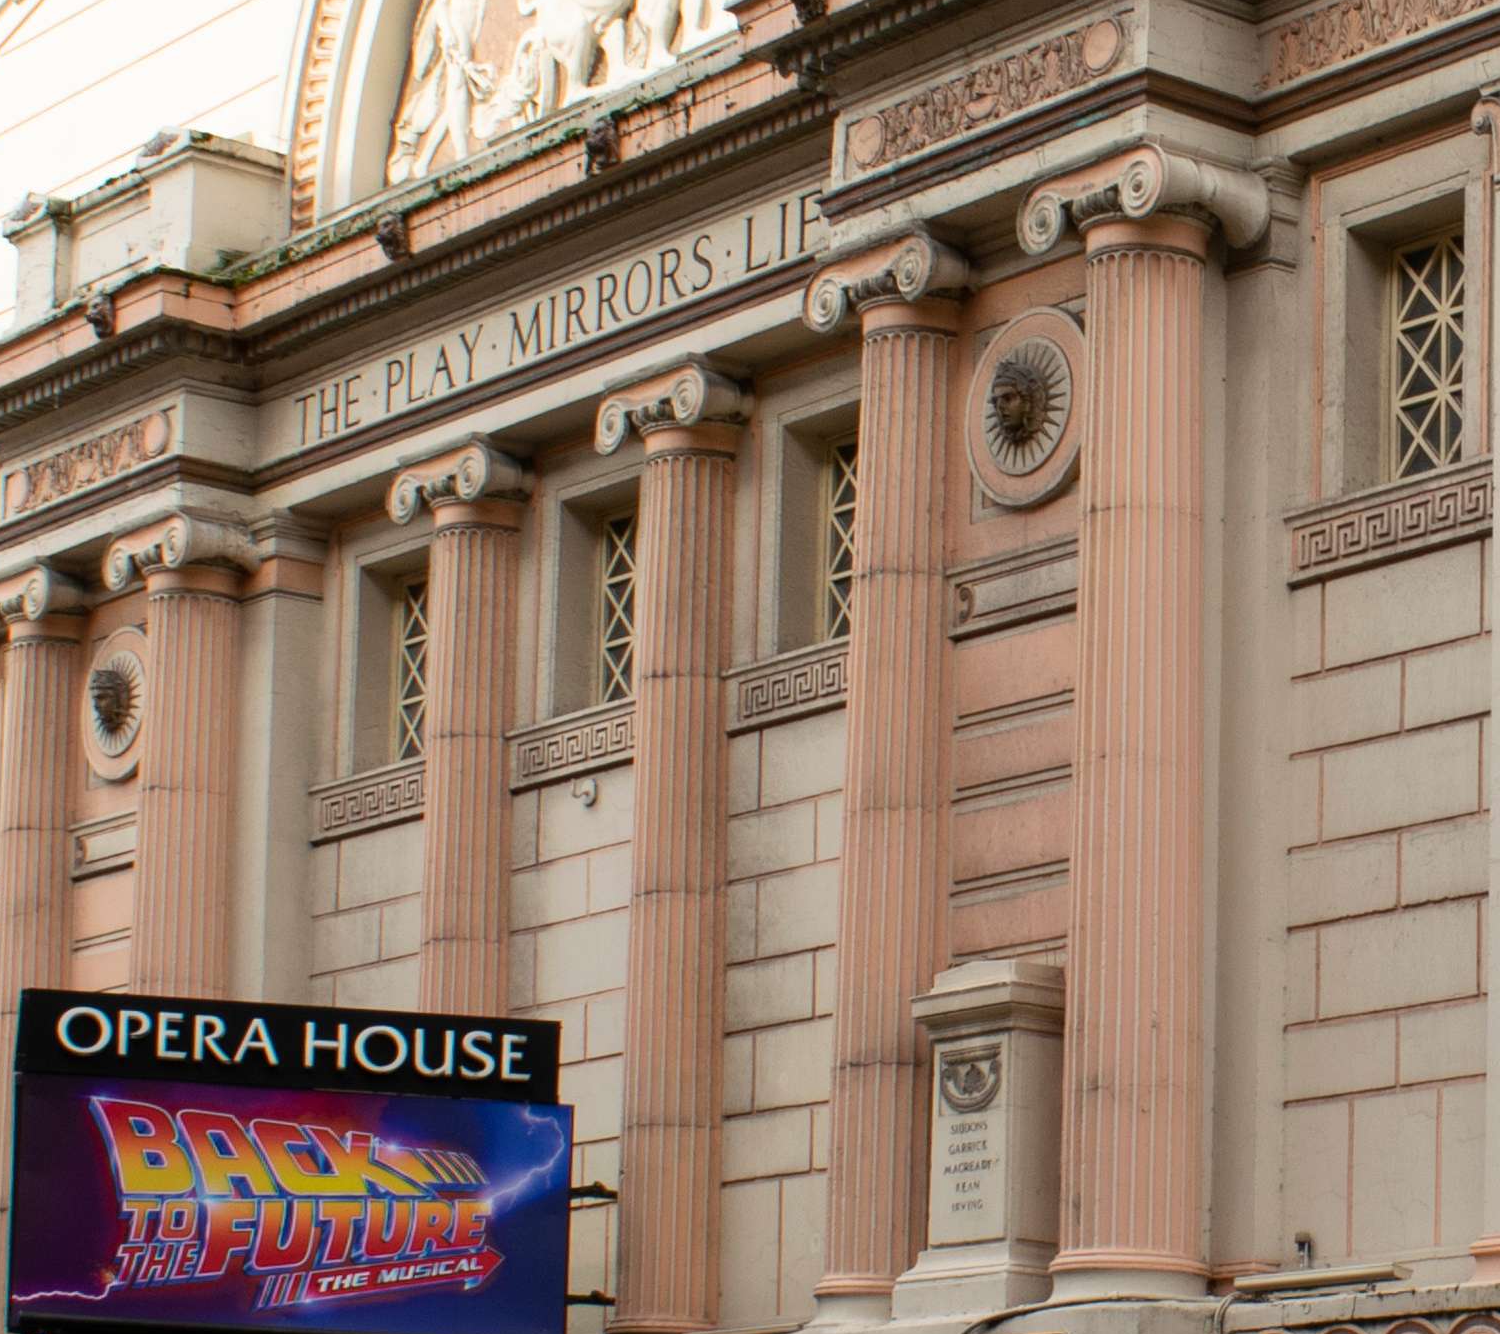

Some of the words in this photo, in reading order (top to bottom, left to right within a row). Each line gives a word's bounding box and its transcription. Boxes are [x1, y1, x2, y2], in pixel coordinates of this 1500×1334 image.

[295, 374, 363, 446] THE
[383, 323, 485, 413] PLAY
[507, 234, 714, 366] MIRRORS
[744, 188, 823, 273] LIF
[56, 1005, 279, 1066] OPERA
[304, 1021, 532, 1082] HOUSE
[89, 1094, 440, 1196] BACK
[112, 1240, 203, 1287] THE
[120, 1198, 198, 1243] TO
[200, 1197, 493, 1277] FUTURE
[316, 1271, 370, 1294] THE
[376, 1257, 484, 1286] MUSICAL
